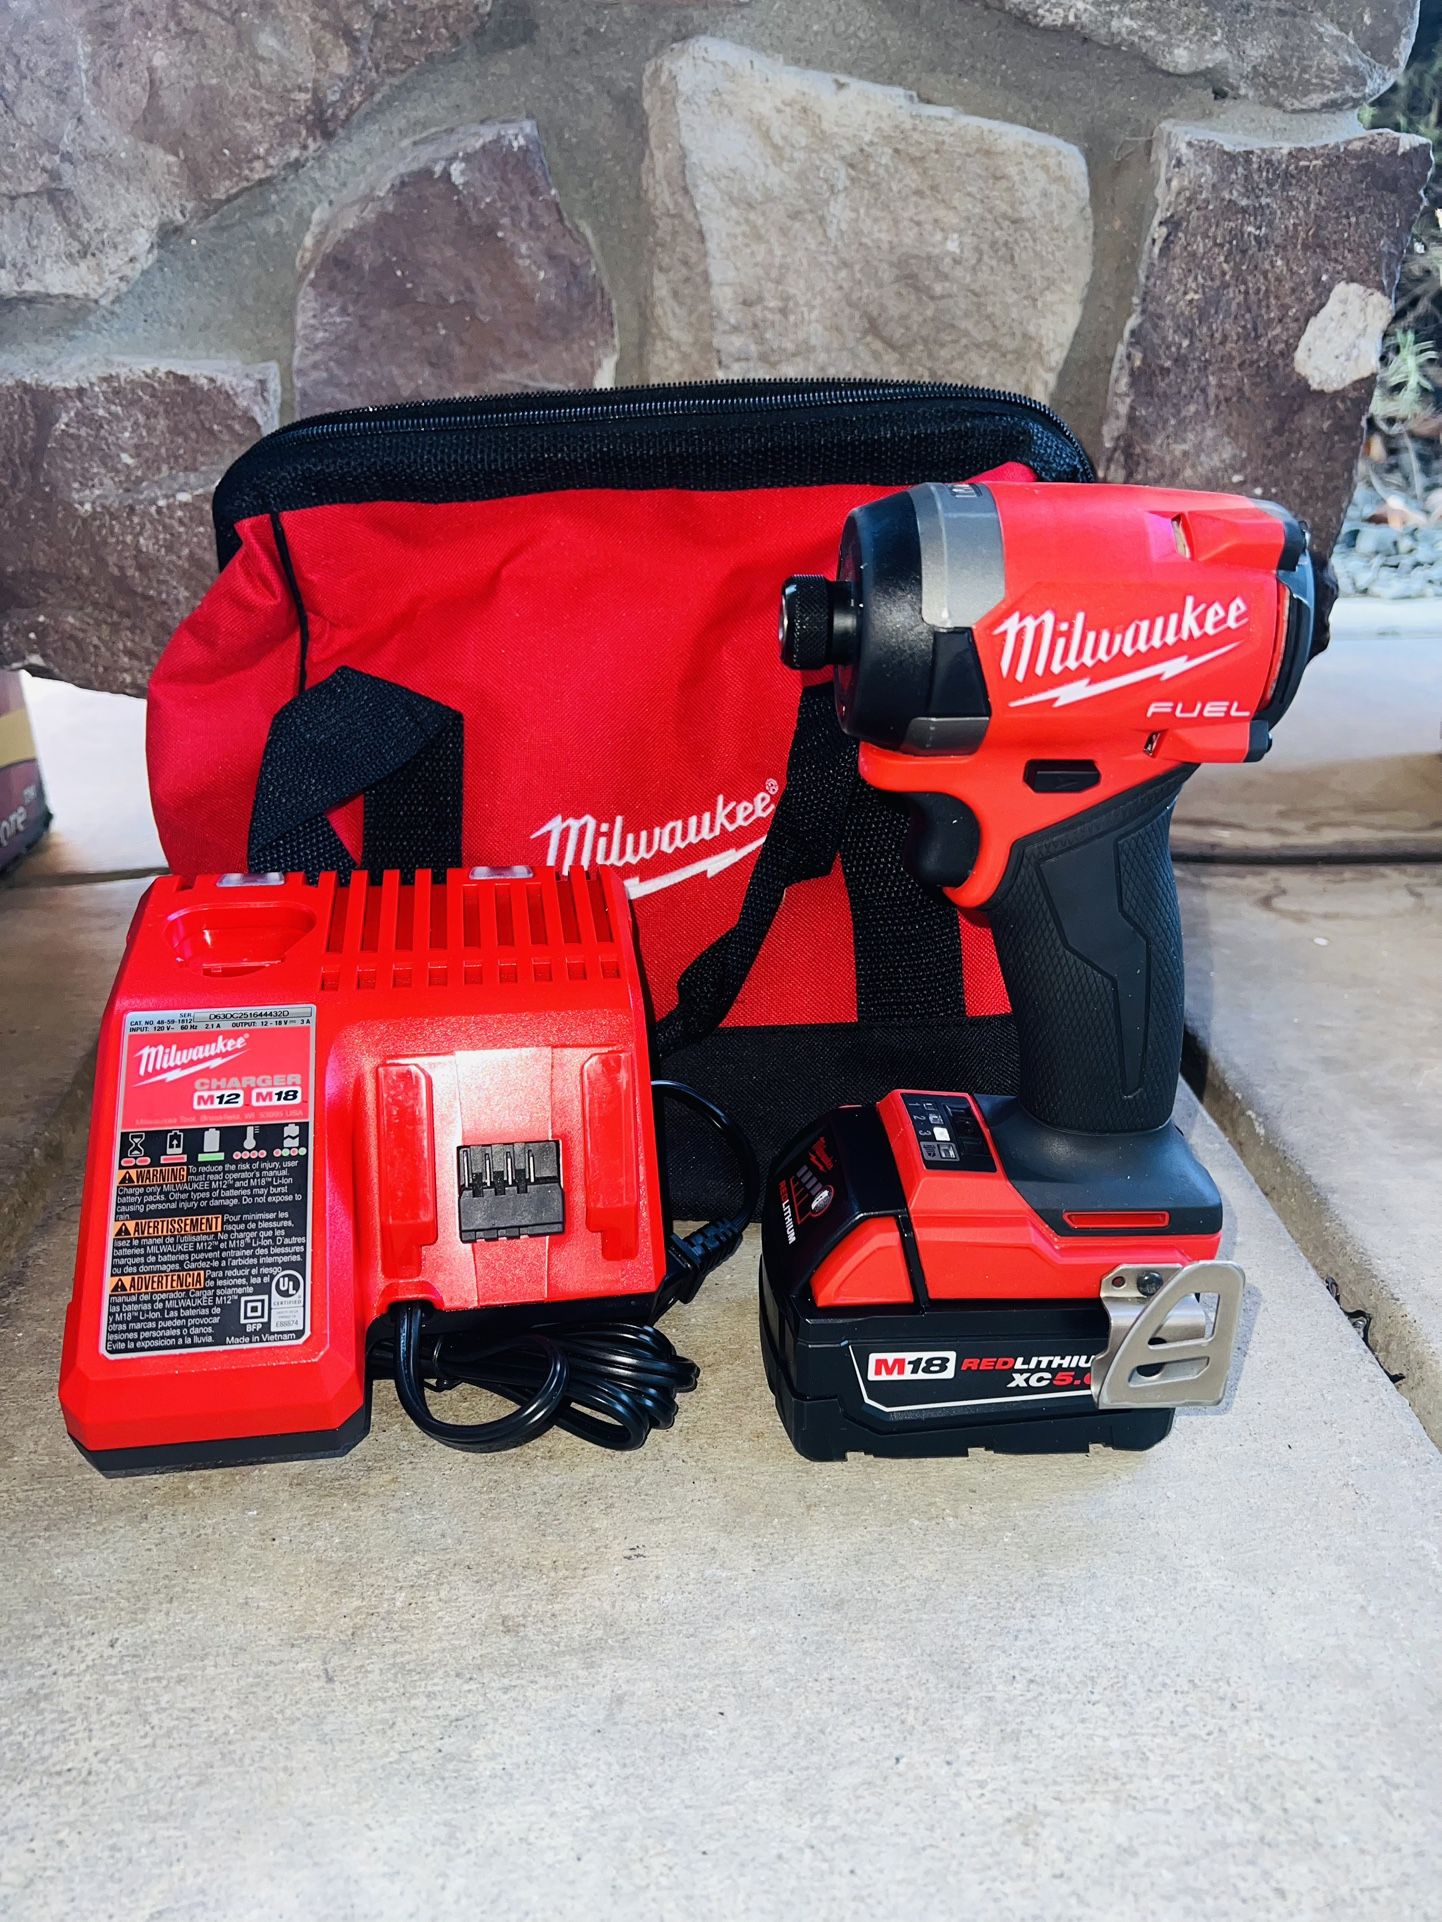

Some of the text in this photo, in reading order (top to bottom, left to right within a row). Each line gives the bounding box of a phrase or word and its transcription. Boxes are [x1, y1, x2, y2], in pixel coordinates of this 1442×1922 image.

[993, 594, 1249, 683] Milwaukee
[1146, 700, 1251, 718] FUEL
[194, 1074, 302, 1090] CHARGER
[136, 1167, 185, 1184] WARNING
[261, 1161, 280, 1170] injury,
[262, 1169, 290, 1177] manual.
[117, 1186, 288, 1204] battery packs. Other types of batteries may burst
[118, 1186, 144, 1196] Charge
[146, 1185, 161, 1194] only
[162, 1181, 210, 1192] MILWAUKEE
[117, 1204, 144, 1213] causing
[146, 1201, 177, 1211] personal
[179, 1200, 198, 1210] injury
[209, 1198, 240, 1207] damage.
[267, 1194, 293, 1203] expose
[779, 1180, 796, 1245] REDLITHIUM
[133, 1216, 221, 1236] AVERTISSEMENT
[224, 1214, 241, 1222] Pour
[242, 1212, 276, 1221] minimiser
[223, 1222, 245, 1232] risque
[141, 1237, 163, 1245] manel
[230, 1230, 257, 1240] charger
[259, 1230, 272, 1240] que
[113, 1257, 145, 1266] marques
[158, 1253, 189, 1262] batteries
[191, 1251, 220, 1260] puevent
[270, 1245, 304, 1254] blessures
[114, 1246, 144, 1256] batteries
[146, 1243, 194, 1254] MILWAUKEE
[220, 1240, 227, 1249] et
[123, 1265, 137, 1273] des
[138, 1263, 181, 1272] dommages.
[183, 1260, 219, 1269] Gardez-le
[129, 1272, 202, 1292] ADVERTENCIA
[206, 1269, 222, 1278] Para
[225, 1267, 250, 1277] reducir
[260, 1266, 282, 1275] riesgo
[205, 1279, 214, 1287] de
[279, 1277, 296, 1295] UL
[110, 1286, 254, 1303] manual del operador. Cargar solamente
[122, 1302, 152, 1312] baterias
[165, 1297, 213, 1308] MILWAUKEE
[180, 1307, 209, 1316] baterias
[108, 1316, 220, 1332] otras marcas pueden provocar
[246, 1324, 262, 1332] BFP
[107, 1341, 125, 1350] Evite
[185, 1336, 191, 1344] la
[193, 1334, 214, 1343] lluvia.
[108, 1332, 138, 1341] lesiones
[140, 1329, 180, 1339] personales
[226, 1336, 250, 1345] Made
[262, 1333, 296, 1342] Vietnam
[874, 1357, 950, 1376] M18
[961, 1354, 1097, 1371] REDLITHIU
